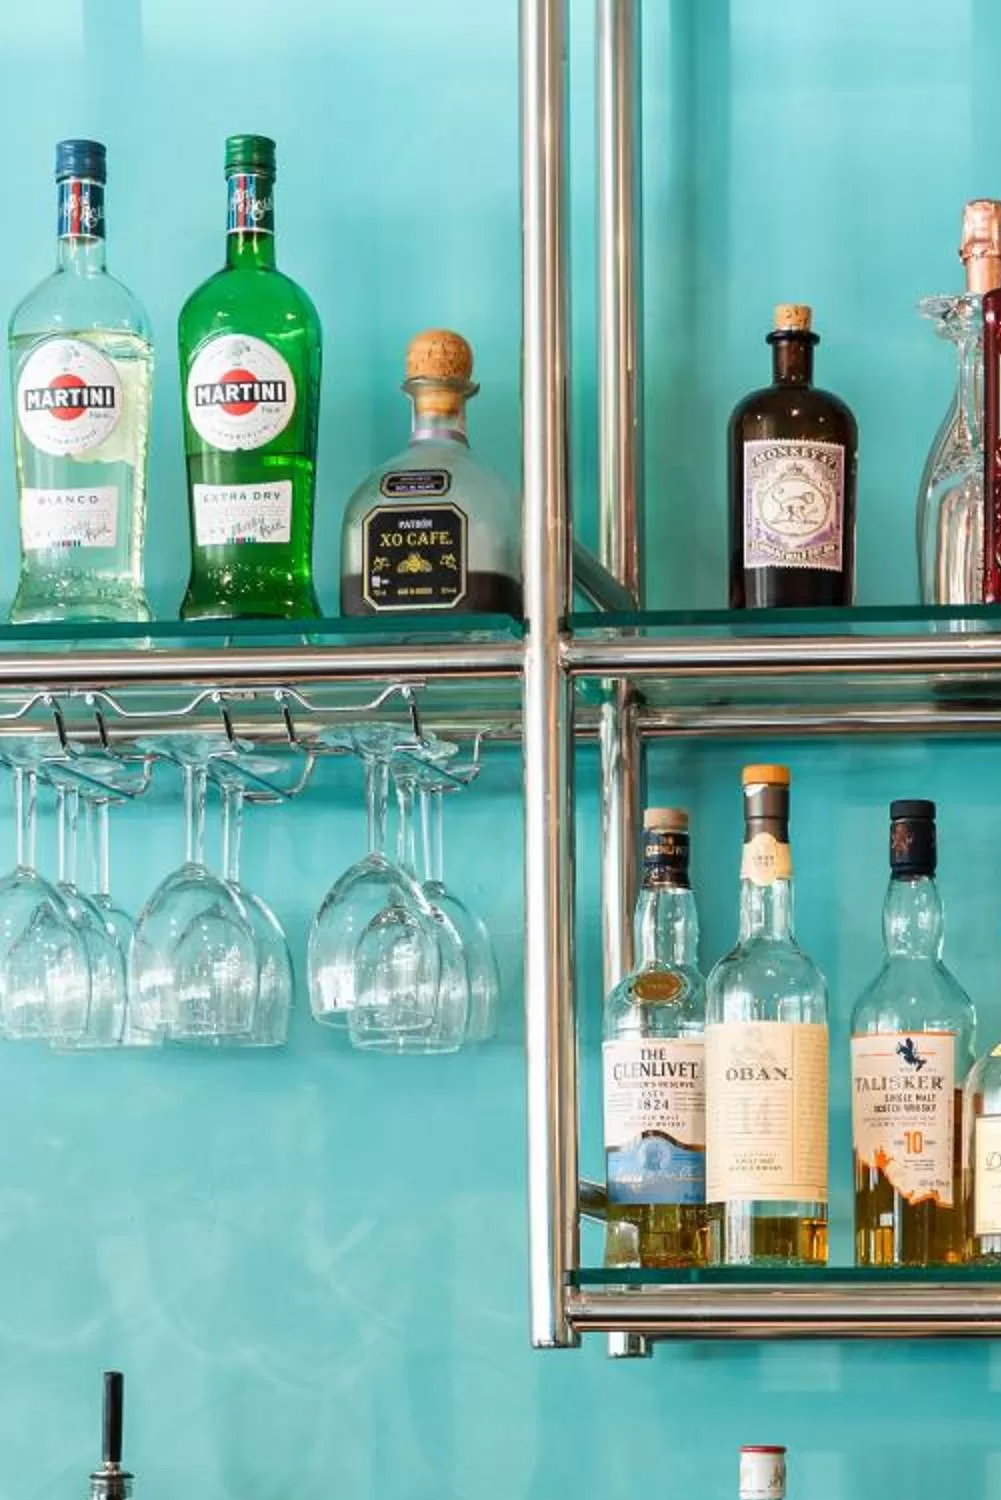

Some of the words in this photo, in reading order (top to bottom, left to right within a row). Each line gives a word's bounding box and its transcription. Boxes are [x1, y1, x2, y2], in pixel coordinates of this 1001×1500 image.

[27, 387, 113, 408] MARTINI
[197, 383, 284, 405] MARTINI
[253, 490, 282, 501] DRY
[380, 533, 403, 547] XO
[641, 1048, 667, 1060] THE
[855, 1076, 944, 1092] TALISKER
[904, 1131, 923, 1154] 10
